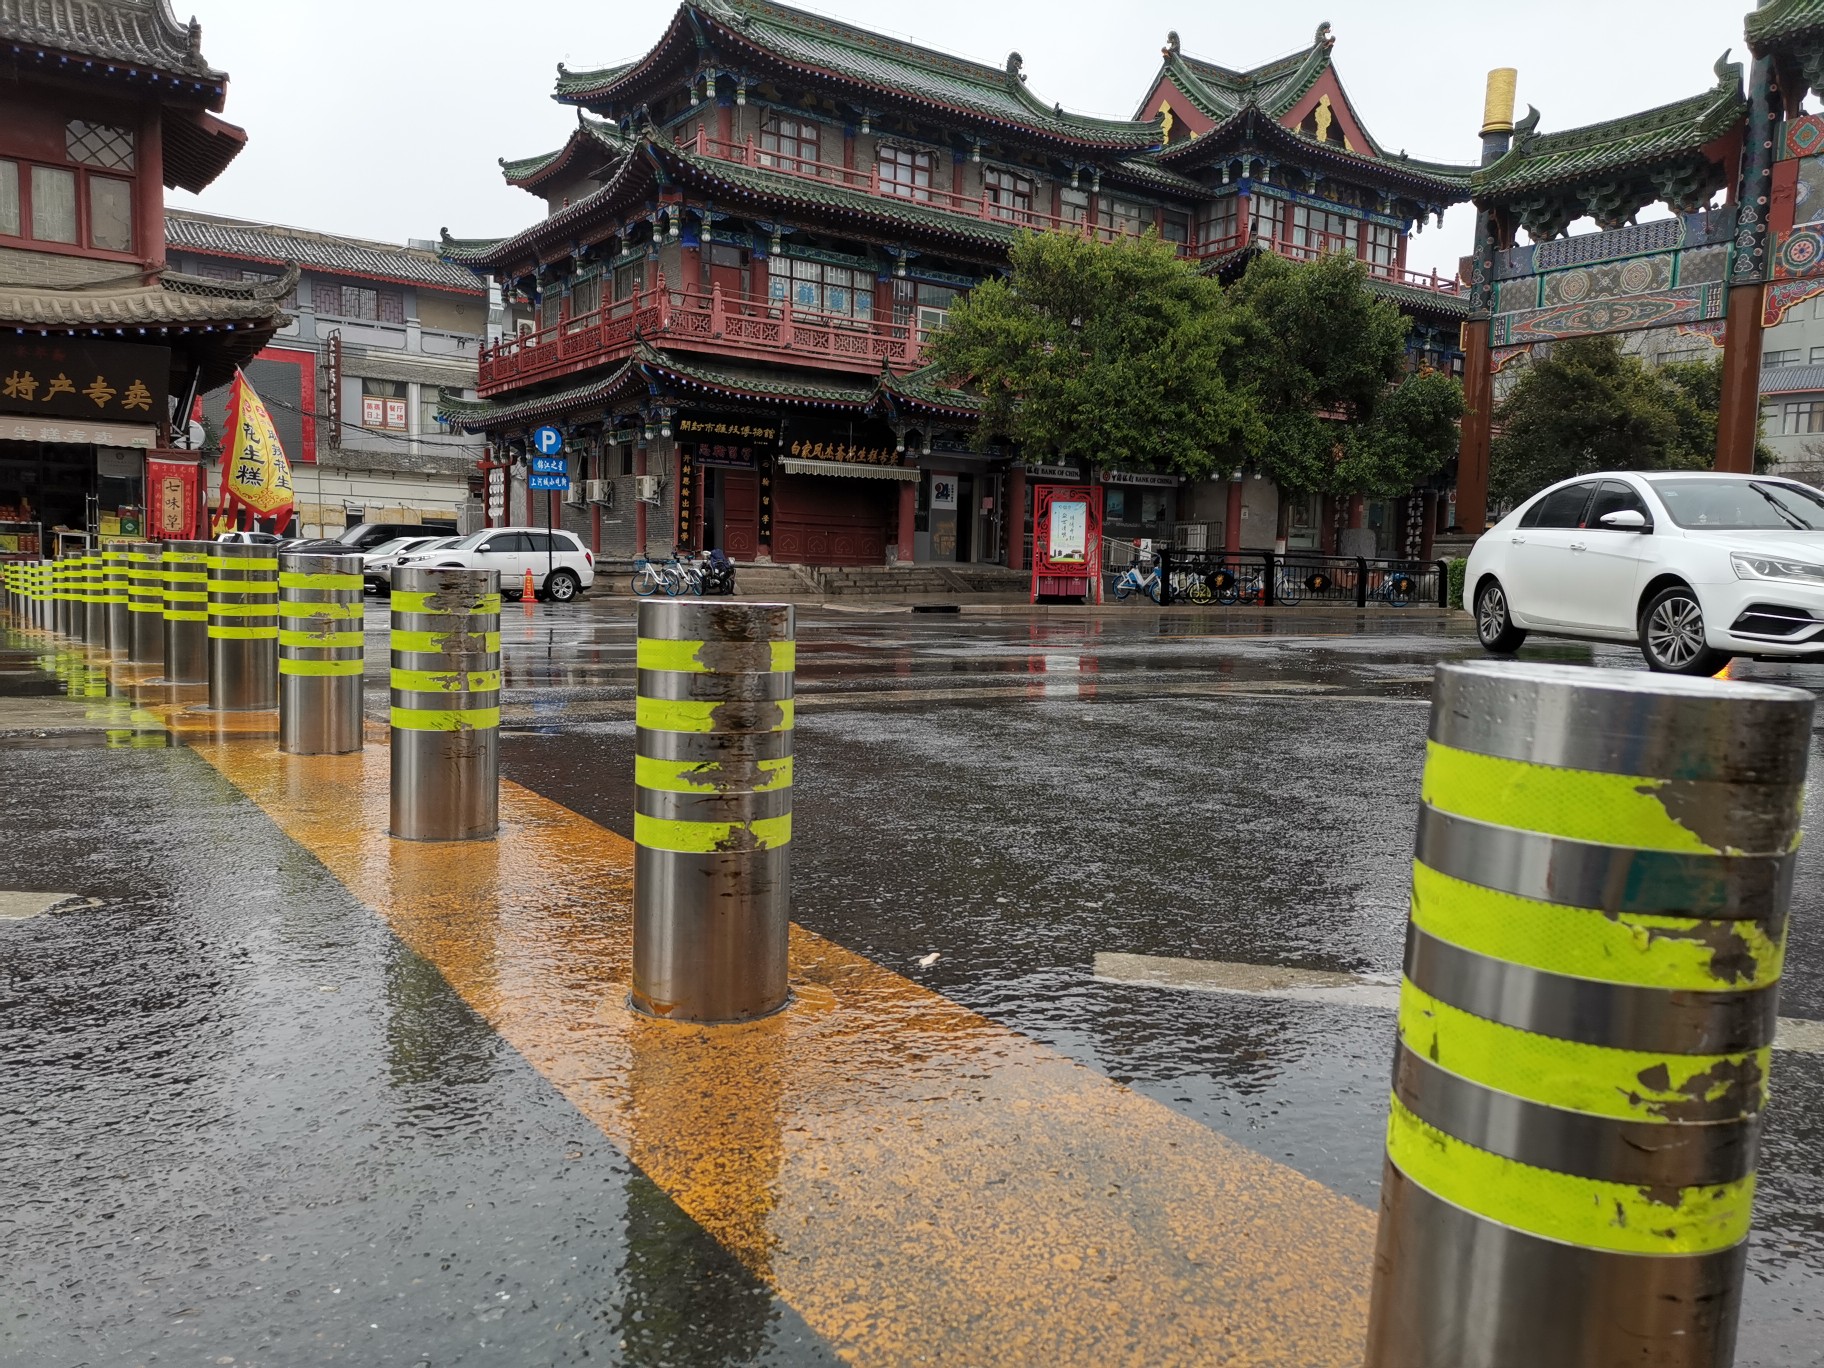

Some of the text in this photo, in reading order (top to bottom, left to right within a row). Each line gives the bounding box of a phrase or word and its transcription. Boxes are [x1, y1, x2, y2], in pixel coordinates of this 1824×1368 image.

[2, 370, 153, 411] 特产专卖
[236, 422, 265, 486] 花生糕
[542, 430, 556, 453] P
[1041, 468, 1057, 476] BANK
